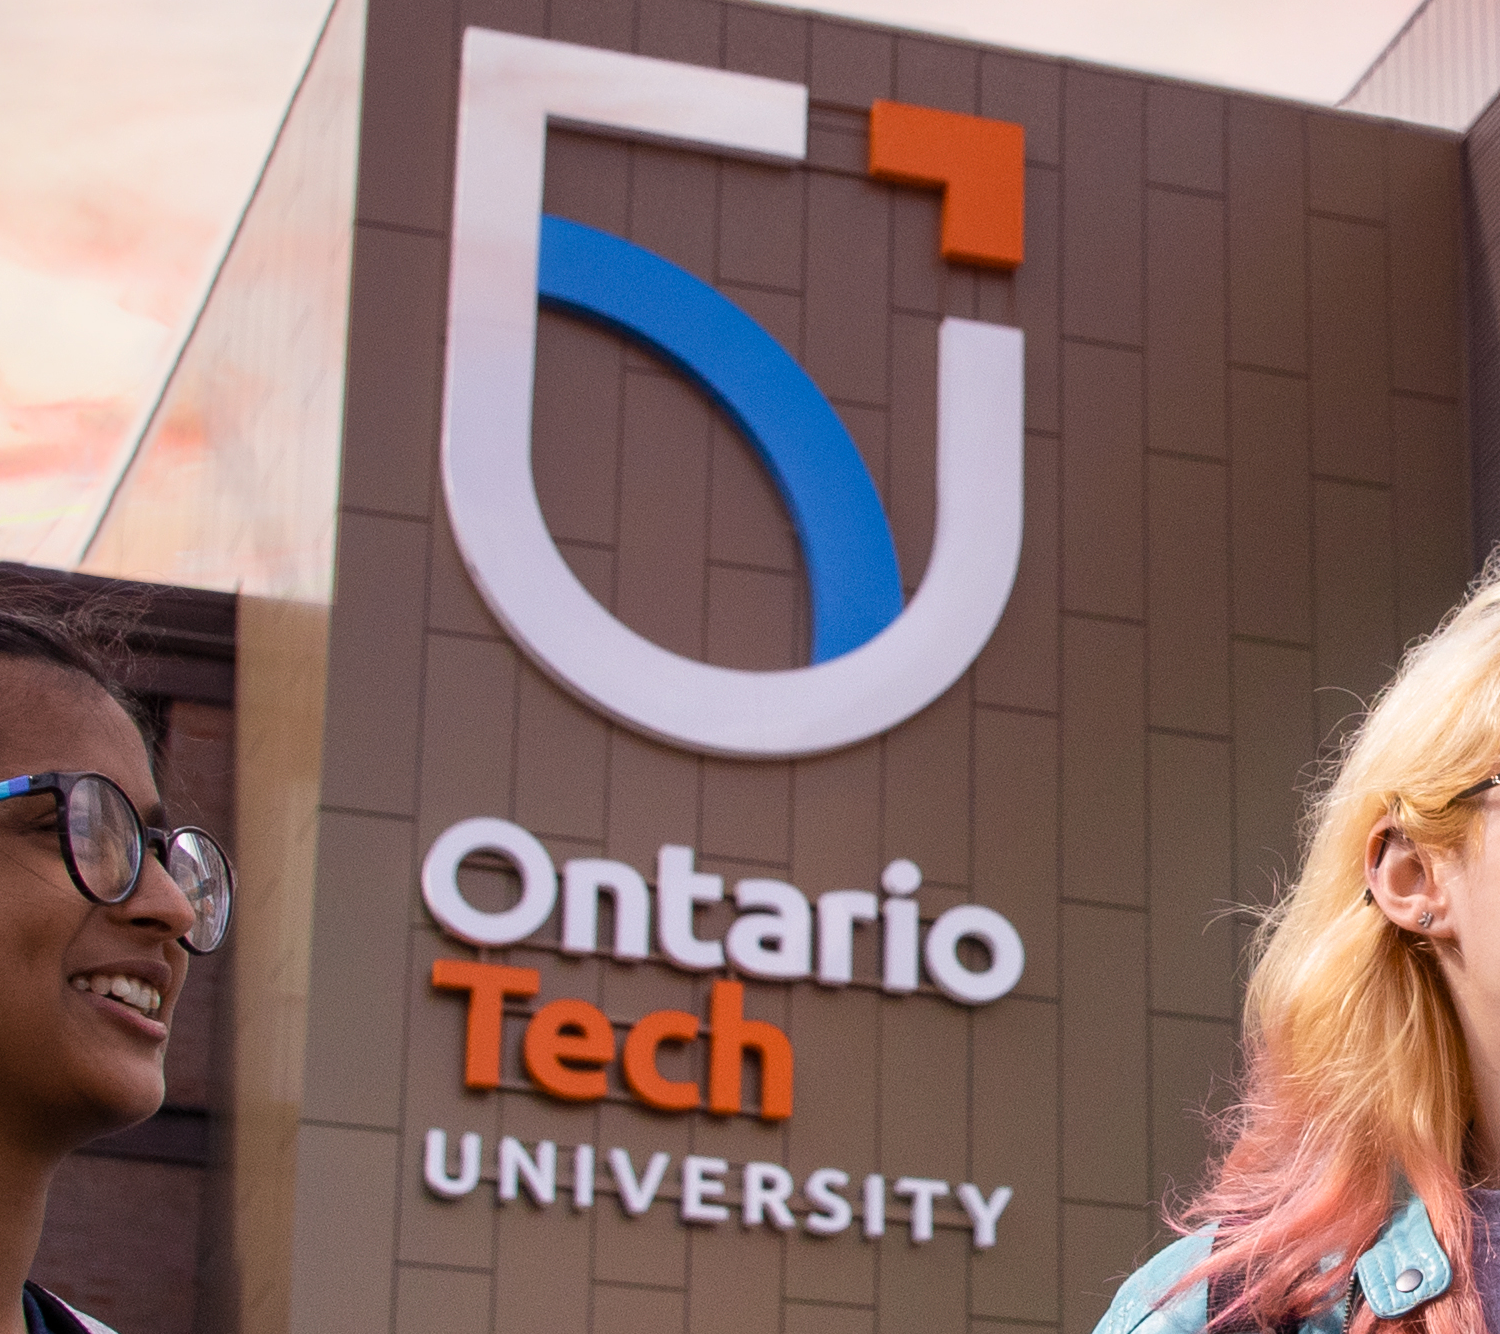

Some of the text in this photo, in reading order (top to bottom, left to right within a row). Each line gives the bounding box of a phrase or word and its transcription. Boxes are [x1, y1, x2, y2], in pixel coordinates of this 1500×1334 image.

[421, 816, 1025, 1005] Ontario
[431, 958, 795, 1120] Tech
[424, 1127, 1014, 1247] UNIVERSITY
